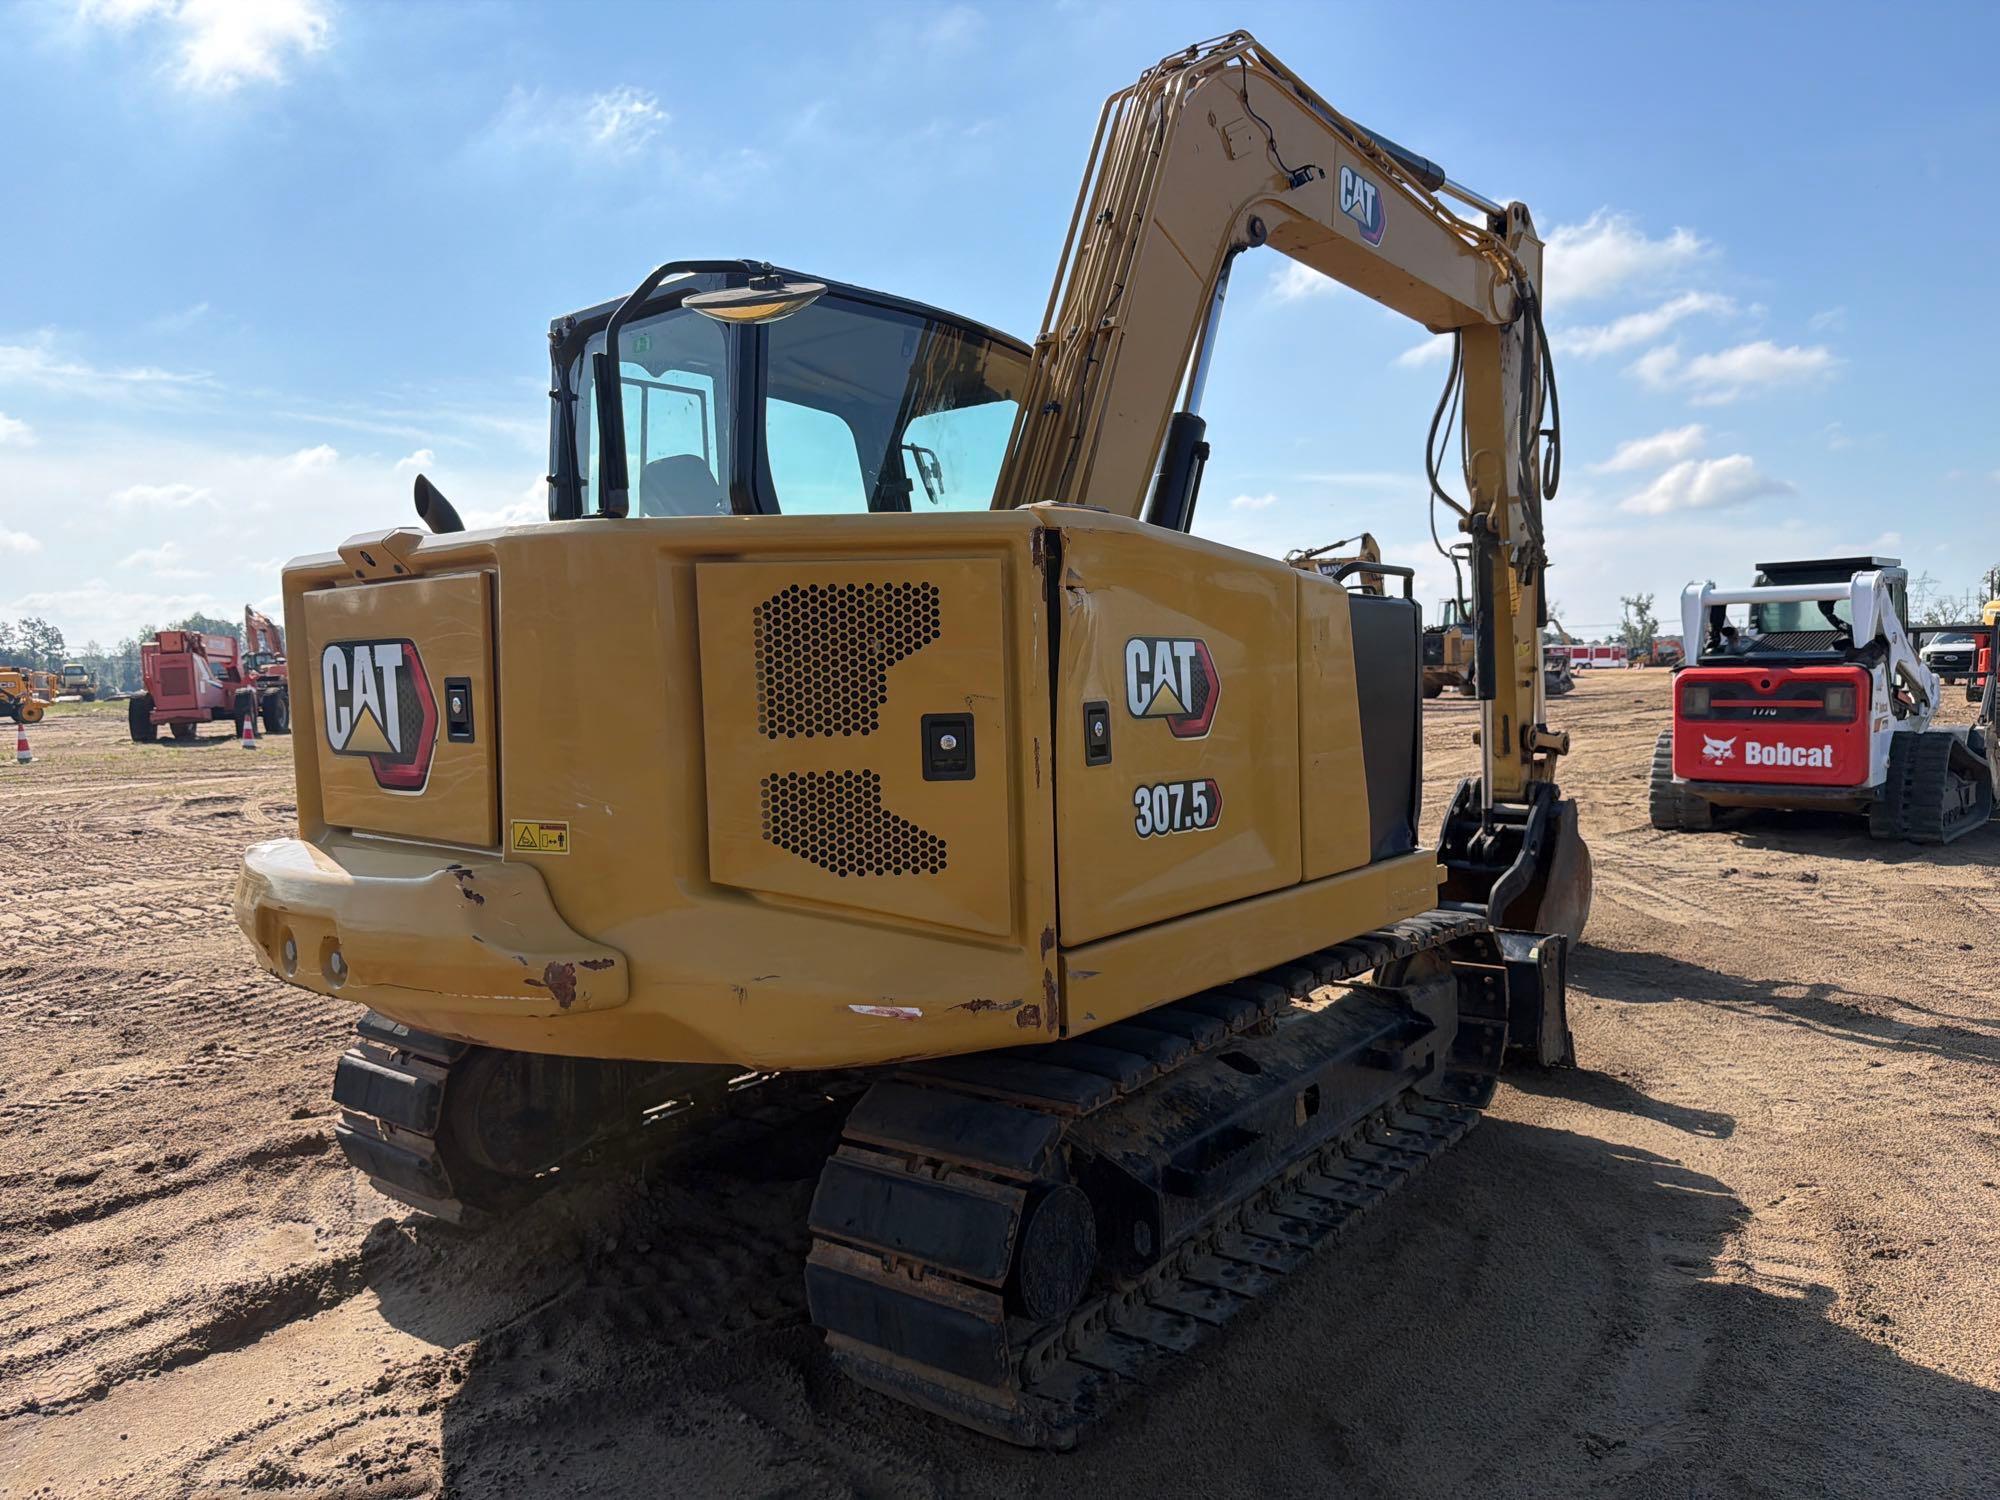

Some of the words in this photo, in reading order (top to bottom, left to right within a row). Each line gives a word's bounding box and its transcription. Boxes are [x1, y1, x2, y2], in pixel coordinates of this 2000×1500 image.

[1341, 167, 1376, 228] CAT
[323, 645, 403, 753] CAT
[1126, 639, 1196, 715] CAT
[1745, 741, 1833, 768] Bobcat
[1135, 781, 1208, 835] 307.5
